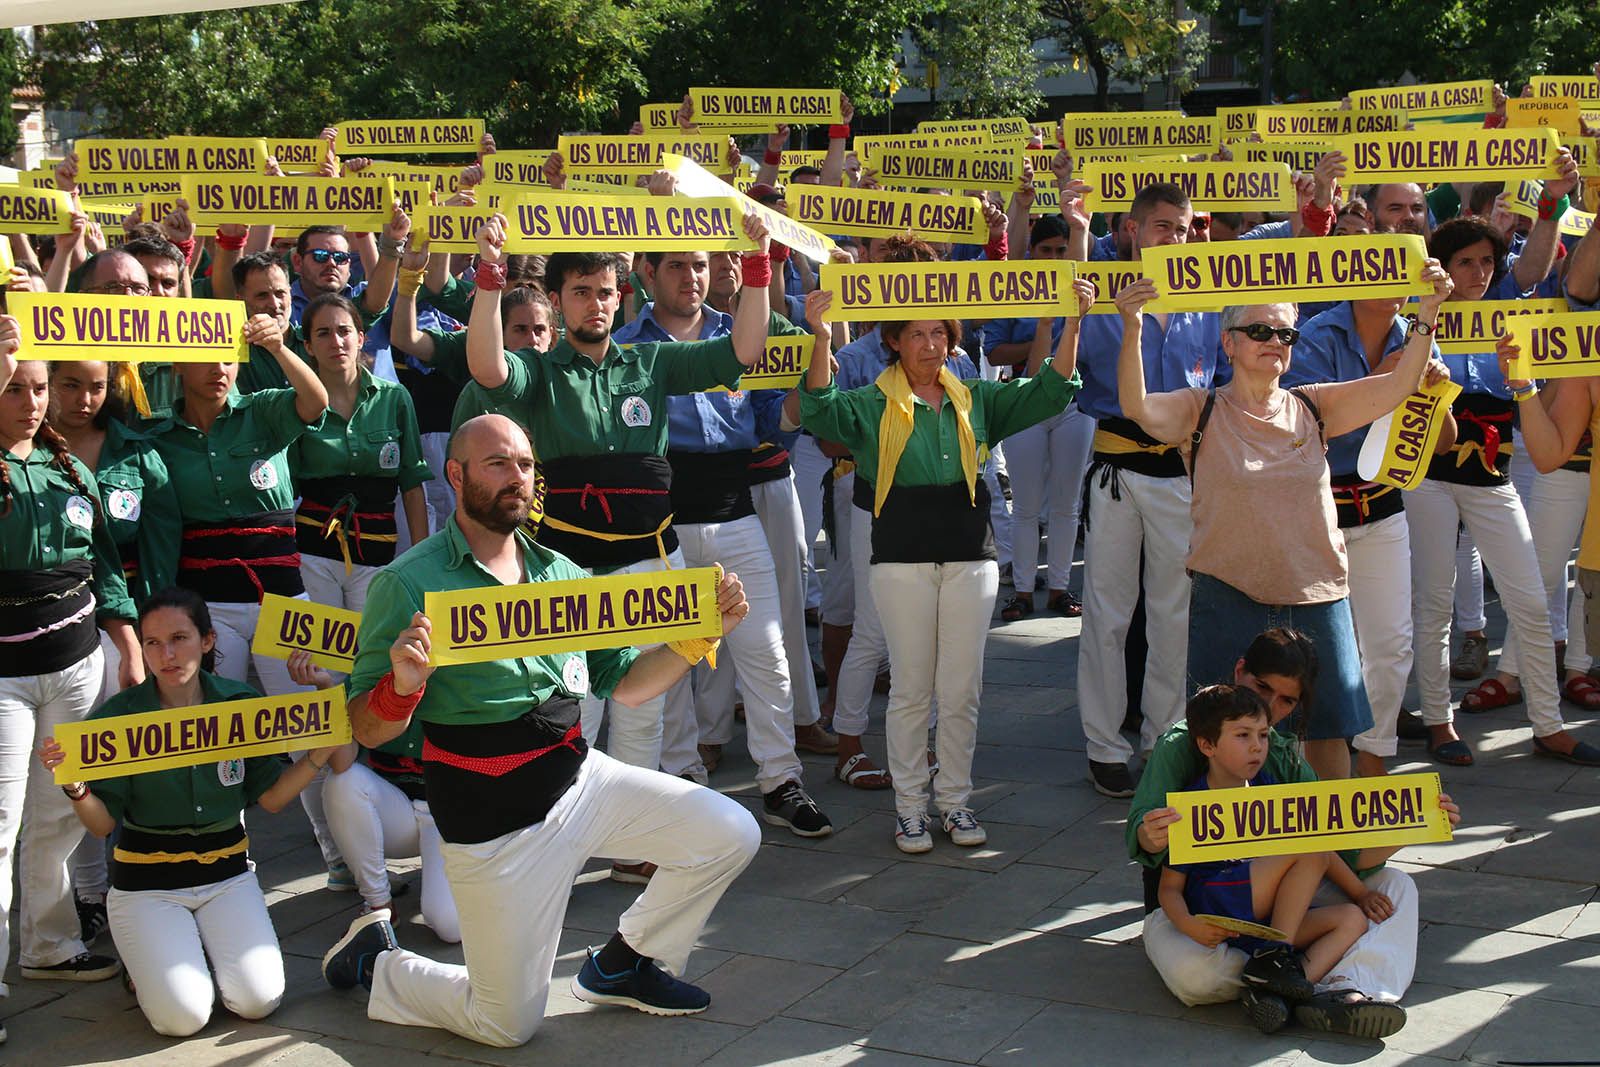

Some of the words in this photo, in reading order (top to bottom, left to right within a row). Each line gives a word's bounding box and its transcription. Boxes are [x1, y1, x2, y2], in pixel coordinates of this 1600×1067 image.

[1431, 90, 1440, 107] A
[1444, 86, 1484, 106] CASA!
[1540, 82, 1557, 98] US
[701, 95, 720, 113] US
[724, 95, 771, 113] VOLEM
[777, 96, 786, 113] A
[790, 96, 831, 114] CASA!
[1519, 102, 1569, 110] REPÚBLICA
[650, 110, 667, 126] US
[991, 122, 1023, 135] CASA!
[1227, 113, 1243, 130] US
[1268, 117, 1286, 133] US
[1291, 116, 1338, 133] VOLEM
[1342, 116, 1351, 132] A
[1538, 116, 1549, 125] ÉS
[346, 127, 364, 144] US
[368, 126, 416, 143] VOLEM
[420, 126, 429, 143] A
[433, 125, 474, 142] CASA!
[1075, 127, 1093, 146] US
[1099, 126, 1148, 146] VOLEM
[1153, 126, 1163, 144] A
[1167, 125, 1211, 144] CASA!
[88, 148, 113, 171] US
[118, 148, 179, 171] VOLEM
[186, 148, 198, 170] A
[203, 147, 255, 170] CASA!
[275, 145, 317, 162] CASA!
[570, 144, 590, 164] US
[596, 143, 650, 163] VOLEM
[1355, 142, 1381, 169] US
[1388, 140, 1458, 168] VOLEM
[1465, 140, 1478, 166] A
[1486, 138, 1547, 165] CASA!
[495, 162, 513, 181] US
[519, 164, 551, 184] VOL
[882, 155, 900, 175] US
[906, 155, 954, 178] VOLEM
[958, 159, 967, 178] A
[972, 160, 1013, 181] CASA!
[197, 184, 224, 209] US
[230, 185, 298, 210] VOLEM
[305, 186, 318, 210] A
[325, 186, 383, 210] CASA!
[1101, 172, 1126, 199] US
[1204, 172, 1216, 198] A
[1223, 172, 1279, 198] CASA!
[1518, 180, 1539, 207] US
[0, 195, 57, 221] CASA!
[1034, 192, 1059, 206] VOL
[518, 204, 551, 235] US
[556, 205, 638, 236] VOLEM
[646, 207, 662, 236] A
[666, 207, 736, 236] CASA!
[800, 194, 824, 220] US
[830, 196, 895, 226] VOLEM
[899, 202, 912, 226] A
[918, 204, 975, 230] CASA!
[429, 215, 454, 240] US
[1166, 256, 1201, 290] US
[1208, 252, 1297, 288] VOLEM
[1306, 251, 1324, 284] A
[1331, 247, 1408, 283] CASA!
[841, 273, 872, 305] US
[879, 272, 957, 304] VOLEM
[966, 271, 982, 302] A
[989, 270, 1058, 301] CASA!
[33, 306, 65, 341] US
[73, 306, 149, 342] VOLEM
[157, 310, 170, 343] A
[177, 310, 233, 344] CASA!
[1470, 311, 1484, 338] A
[1531, 326, 1568, 360] US
[1394, 390, 1435, 462] CASA!
[1387, 467, 1411, 484] A
[450, 603, 488, 644] US
[496, 594, 588, 639] VOLEM
[597, 591, 615, 629] A
[623, 583, 700, 627] CASA!
[280, 609, 313, 646] US
[81, 729, 117, 765] US
[125, 715, 218, 759] VOLEM
[227, 712, 245, 744] A
[254, 700, 331, 740] CASA!
[1192, 803, 1225, 842] US
[1233, 796, 1318, 837] VOLEM
[1327, 793, 1344, 830] A
[1351, 787, 1425, 828] CASA!
